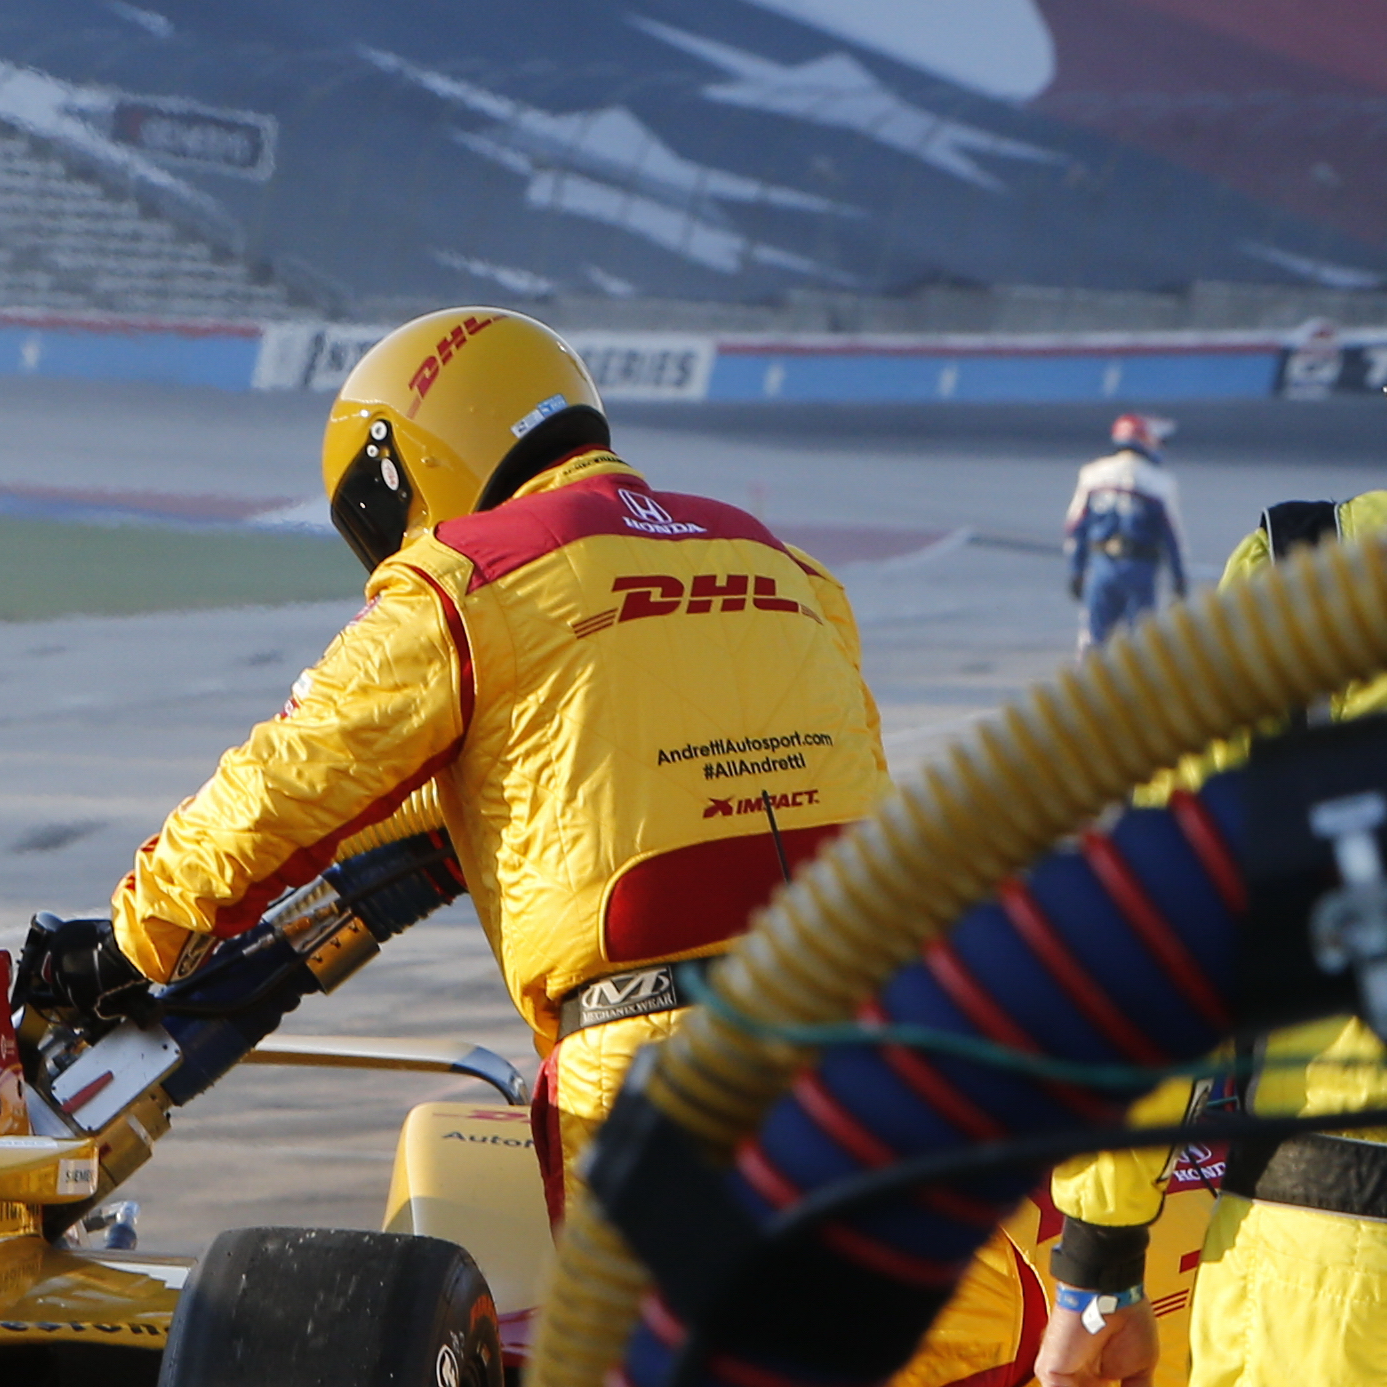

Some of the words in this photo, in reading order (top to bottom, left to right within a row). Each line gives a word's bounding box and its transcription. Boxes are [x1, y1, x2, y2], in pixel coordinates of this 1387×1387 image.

[408, 316, 493, 400] DHL
[622, 515, 708, 535] HONDA
[611, 574, 800, 623] DHL
[656, 730, 834, 768] AndrettiAutosport.com
[702, 752, 807, 781] #AllAndretti
[636, 992, 674, 1013] WEAR
